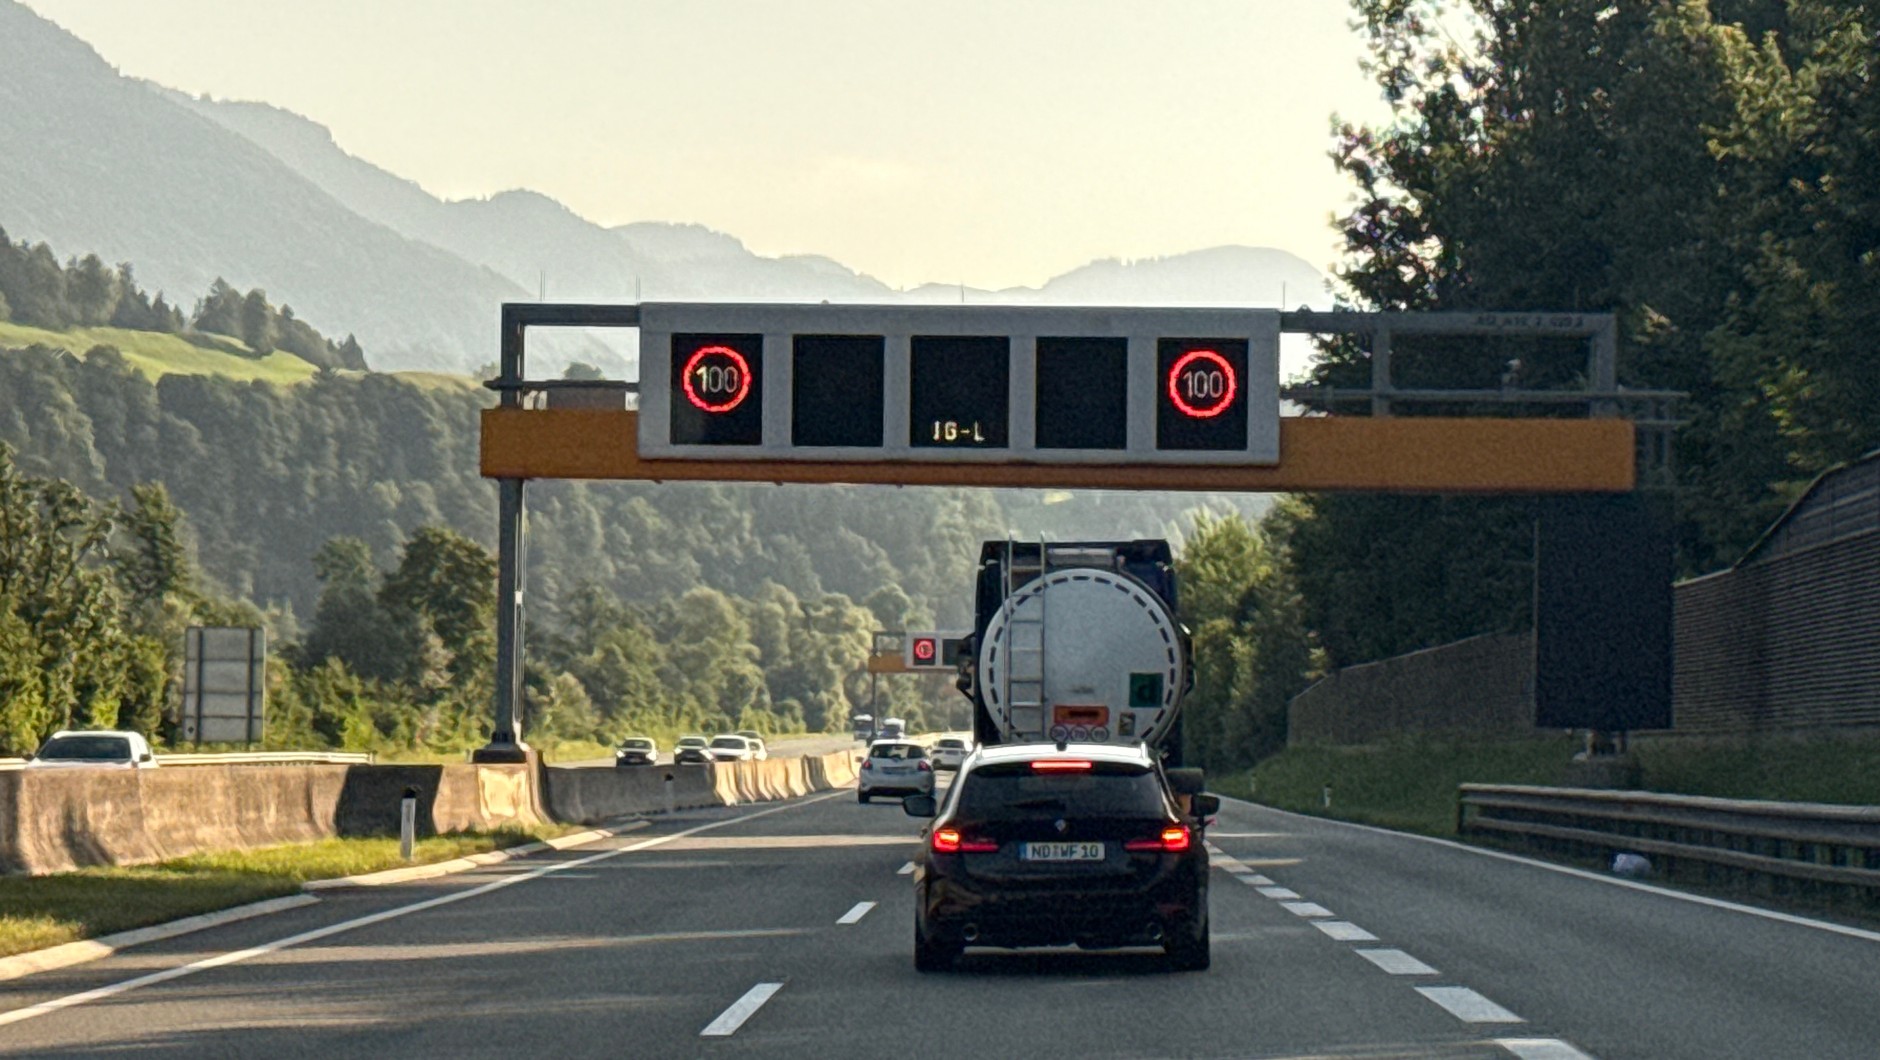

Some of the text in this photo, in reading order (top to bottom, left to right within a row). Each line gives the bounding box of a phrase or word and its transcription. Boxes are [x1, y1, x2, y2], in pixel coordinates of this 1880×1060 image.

[696, 365, 738, 393] 100
[1183, 370, 1223, 399] 100
[933, 420, 985, 441] IG-L
[1081, 844, 1099, 858] 10
